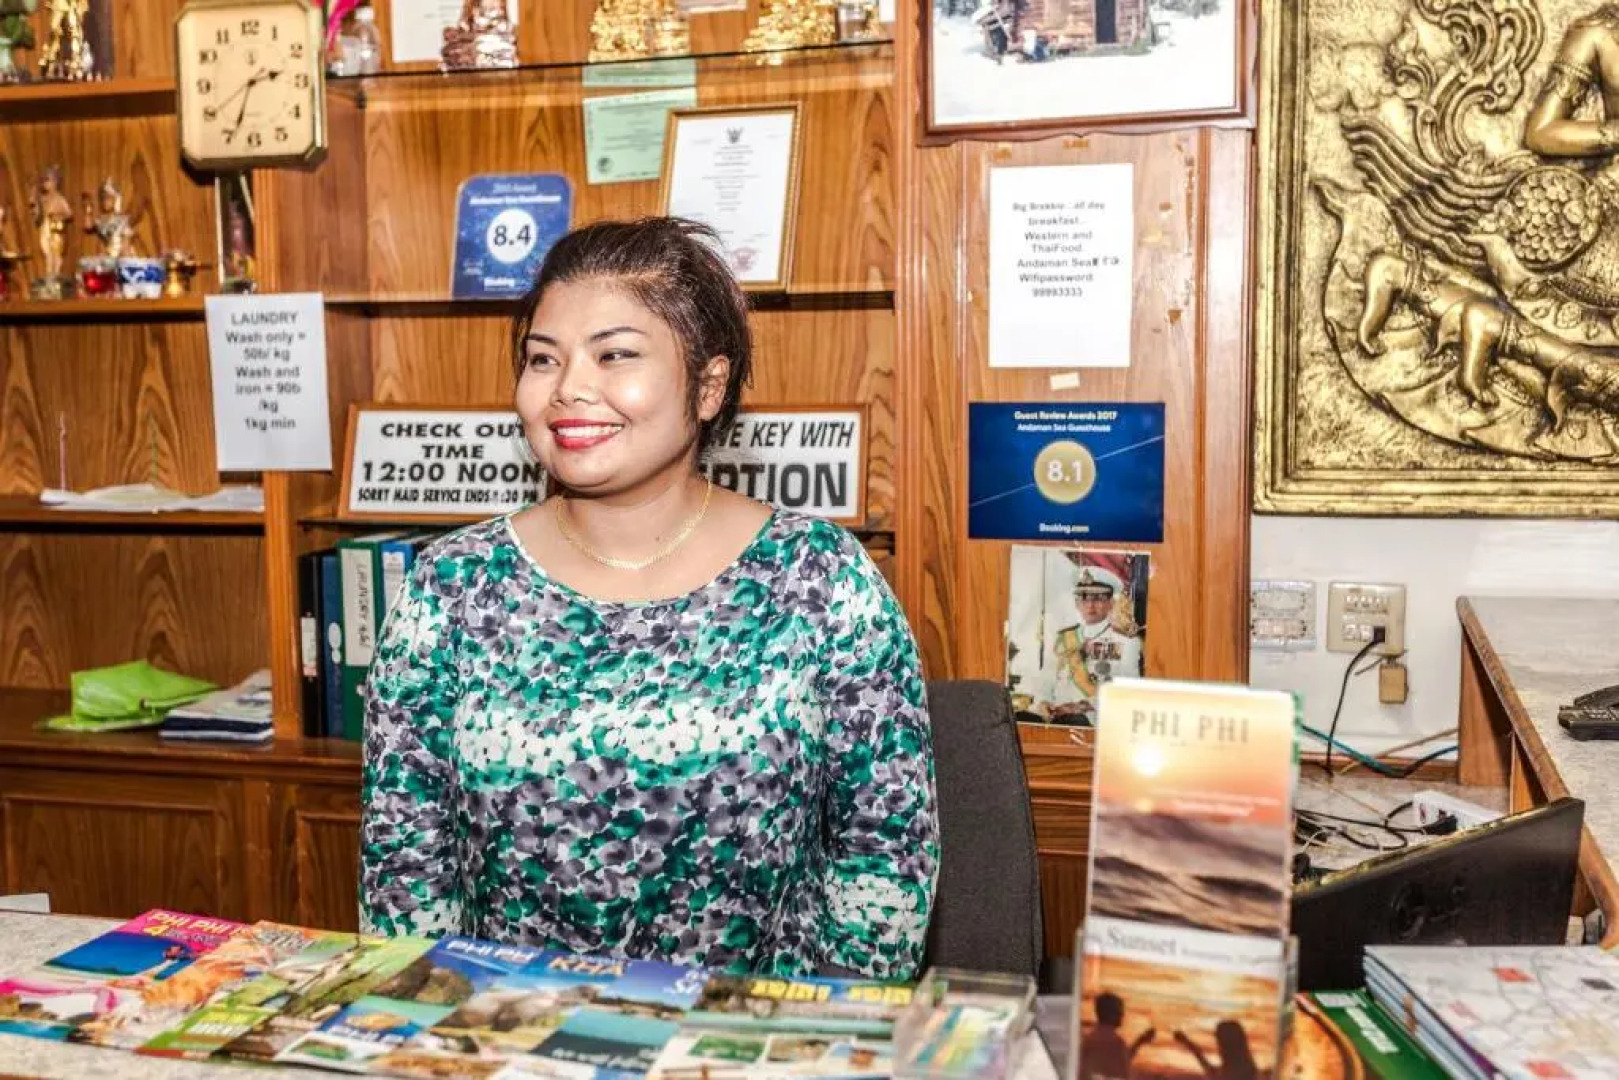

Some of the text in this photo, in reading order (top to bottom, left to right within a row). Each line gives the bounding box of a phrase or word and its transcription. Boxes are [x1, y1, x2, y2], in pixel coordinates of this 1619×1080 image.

[240, 19, 260, 36] 12
[271, 24, 278, 41] 1
[216, 28, 230, 45] 11
[199, 49, 218, 65] 10
[290, 42, 303, 59] 2
[196, 78, 211, 95] 9
[294, 73, 309, 89] 3
[288, 104, 301, 120] 4
[247, 132, 262, 148] 6
[274, 126, 288, 142] 5
[493, 224, 532, 247] 8.4
[1024, 230, 1093, 241] Western and
[1017, 258, 1068, 268] Andaman
[231, 311, 299, 325] LAUNDRY
[225, 331, 263, 343] Wash
[266, 331, 294, 345] only
[274, 348, 291, 362] kg
[235, 366, 301, 378] Wash and
[1014, 410, 1118, 421] Guest Review Awards 2017
[244, 417, 296, 432] 1kg min
[381, 423, 526, 438] CHECK OUT
[1017, 423, 1111, 432] Andaman Sea Guesthouse
[751, 421, 793, 448] KEY
[800, 421, 855, 448] WITH
[421, 444, 485, 459] TIME
[362, 461, 542, 483] 12:00 NOON
[1047, 459, 1083, 482] 8.1
[700, 462, 847, 507] PTION
[393, 488, 420, 502] MAID
[423, 488, 461, 503] SERVICE
[465, 488, 489, 503] ENDS
[522, 489, 539, 504] PM
[1039, 522, 1090, 534] Booking.com
[1131, 709, 1250, 744] PHI PHI
[148, 911, 191, 927] PHI
[188, 919, 232, 935] PHI
[447, 940, 494, 956] PHI
